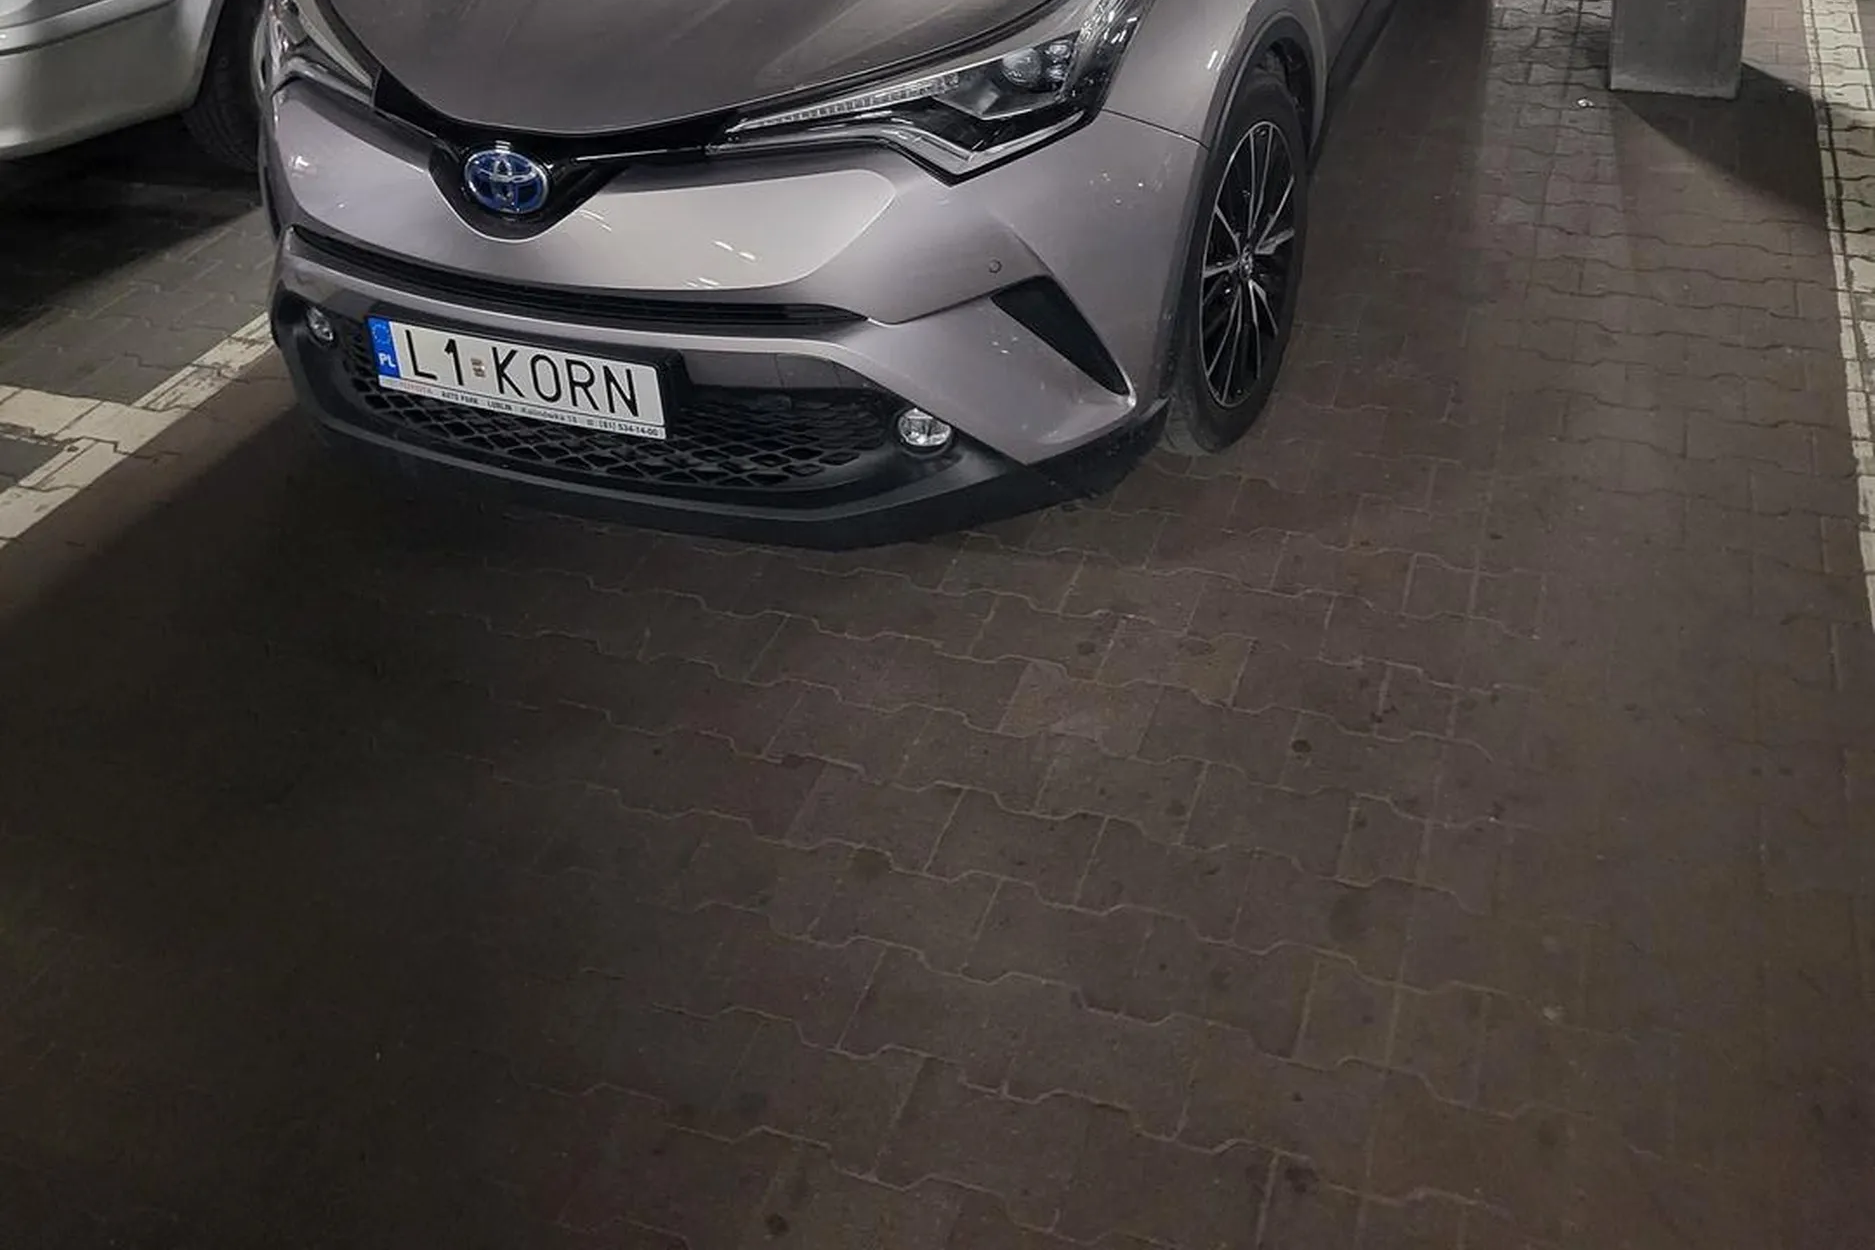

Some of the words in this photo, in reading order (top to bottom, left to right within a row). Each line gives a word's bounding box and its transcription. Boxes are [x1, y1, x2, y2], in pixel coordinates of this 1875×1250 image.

[379, 353, 397, 369] PL
[404, 329, 464, 386] L1
[491, 346, 640, 418] KORN
